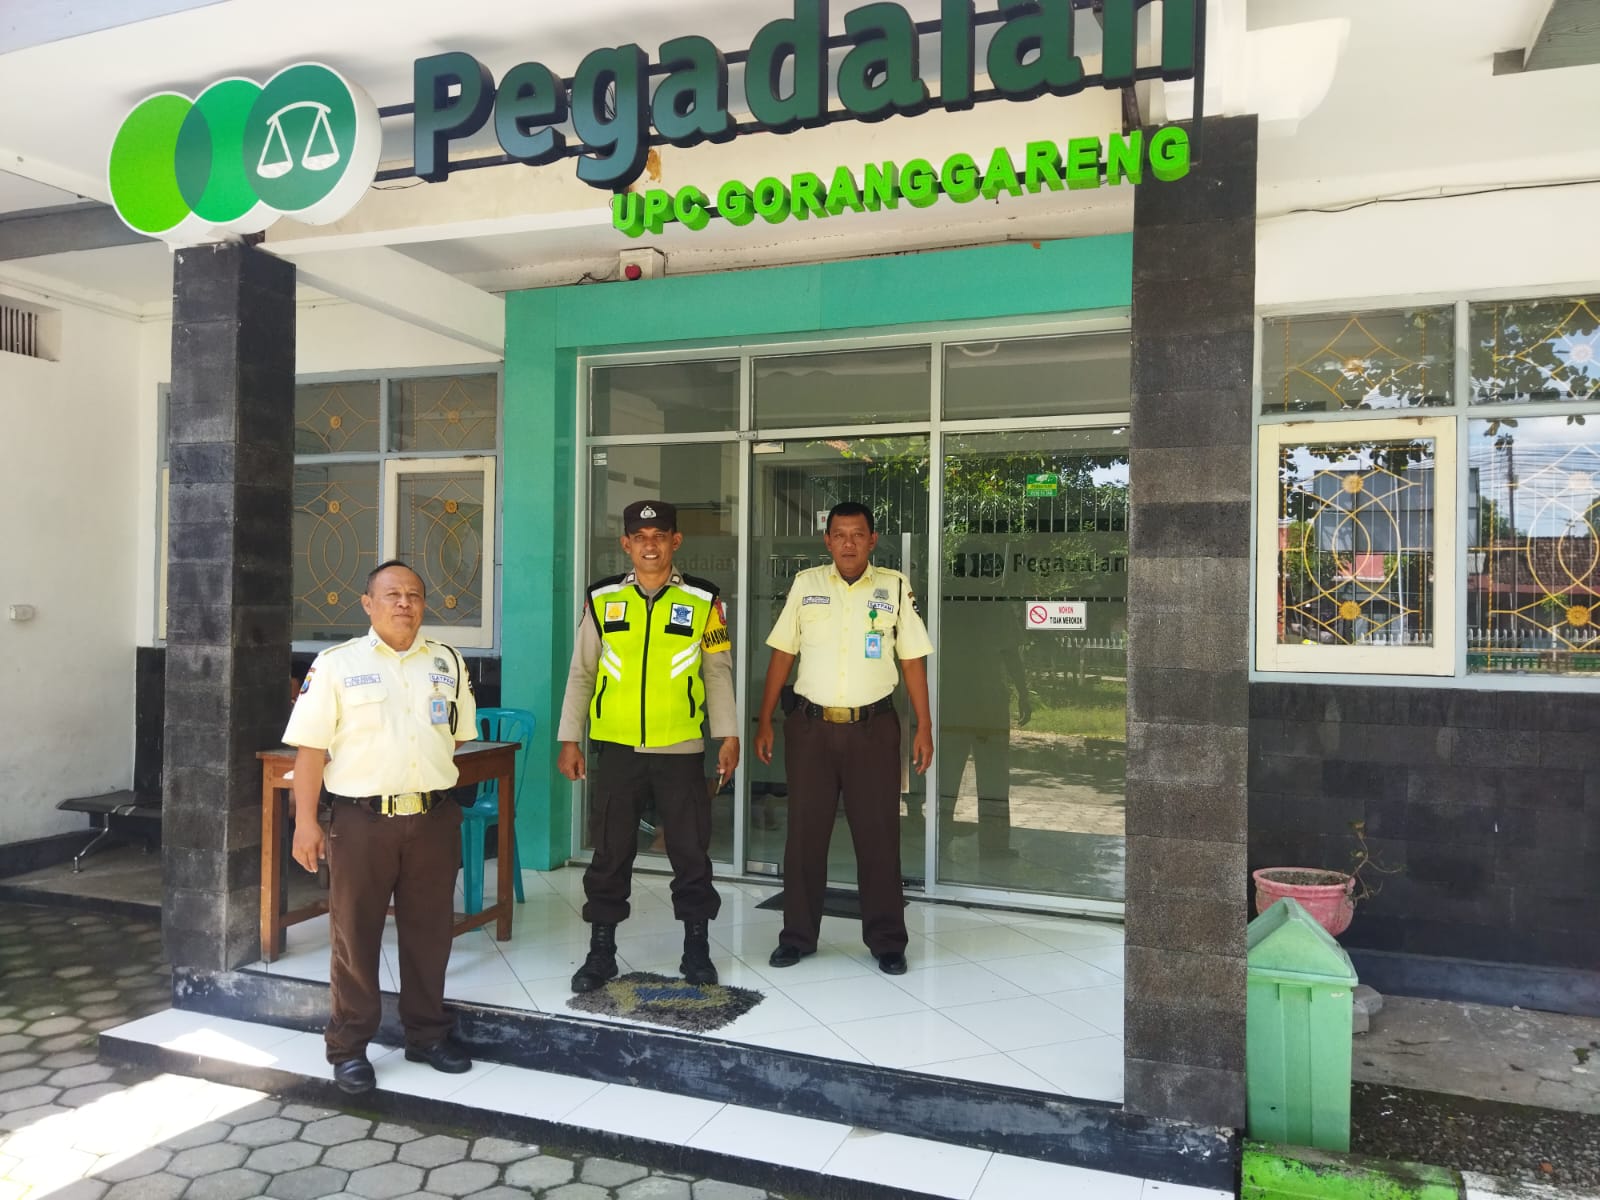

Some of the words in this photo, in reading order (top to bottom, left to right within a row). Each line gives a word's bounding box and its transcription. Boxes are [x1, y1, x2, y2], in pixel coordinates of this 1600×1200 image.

[612, 185, 710, 238] UPC
[717, 127, 1190, 226] GORANGGARENG
[869, 601, 892, 612] SATPAM
[430, 674, 455, 686] SATPAM
